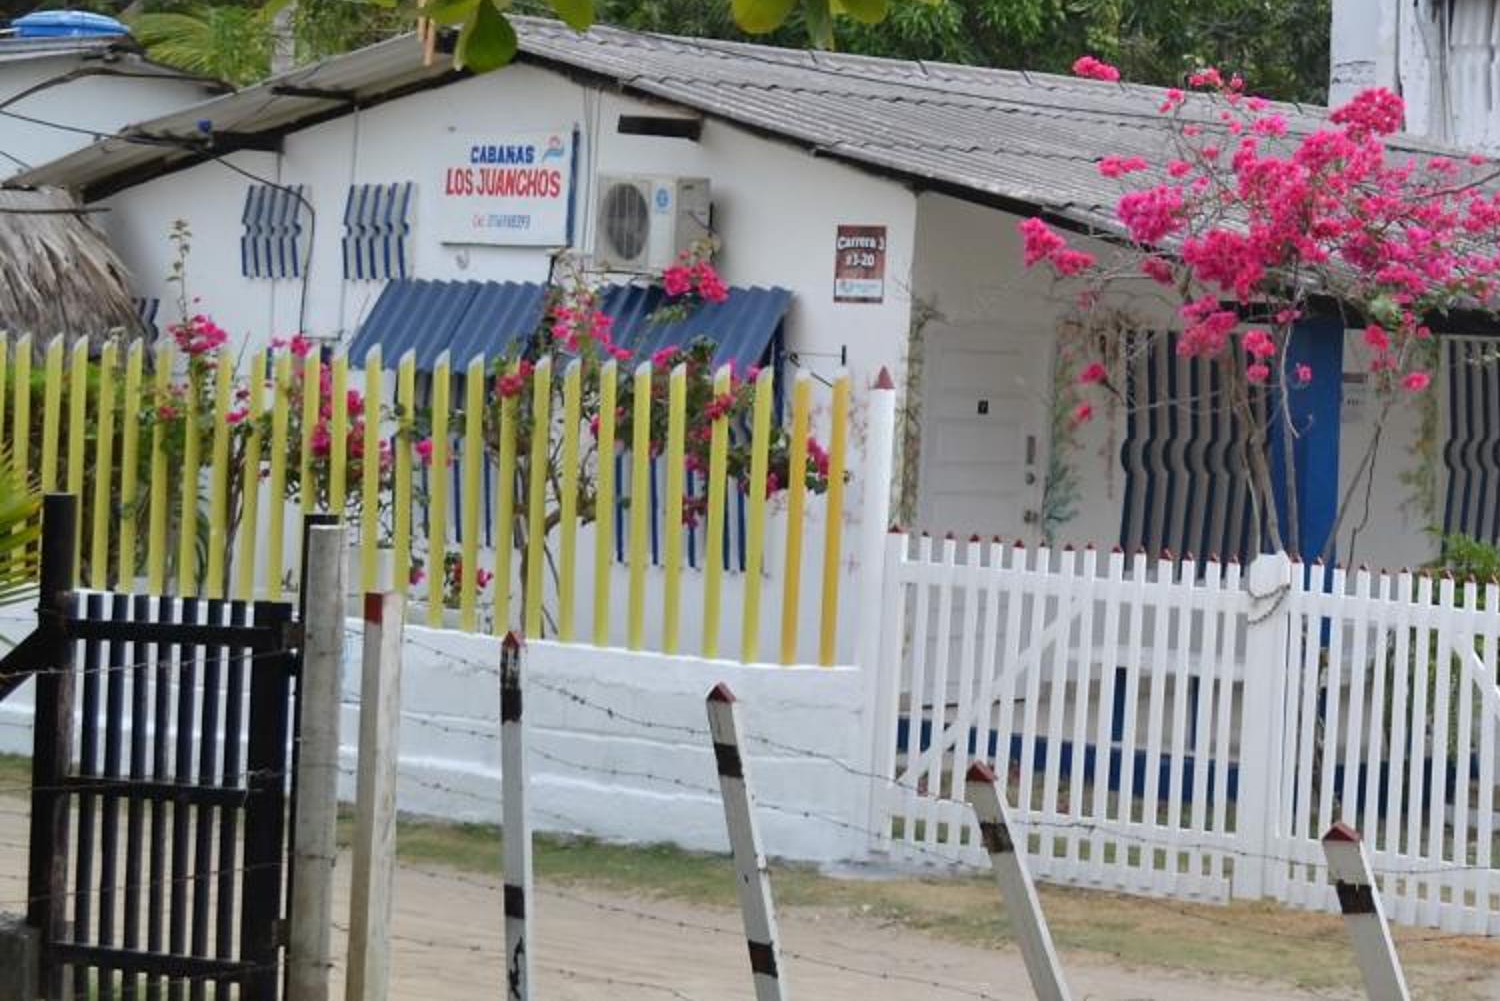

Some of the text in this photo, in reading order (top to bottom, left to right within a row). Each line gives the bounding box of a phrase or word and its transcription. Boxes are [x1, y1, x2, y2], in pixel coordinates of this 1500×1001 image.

[446, 168, 561, 198] LOS JUANCHOS
[837, 236, 876, 249] Carrera
